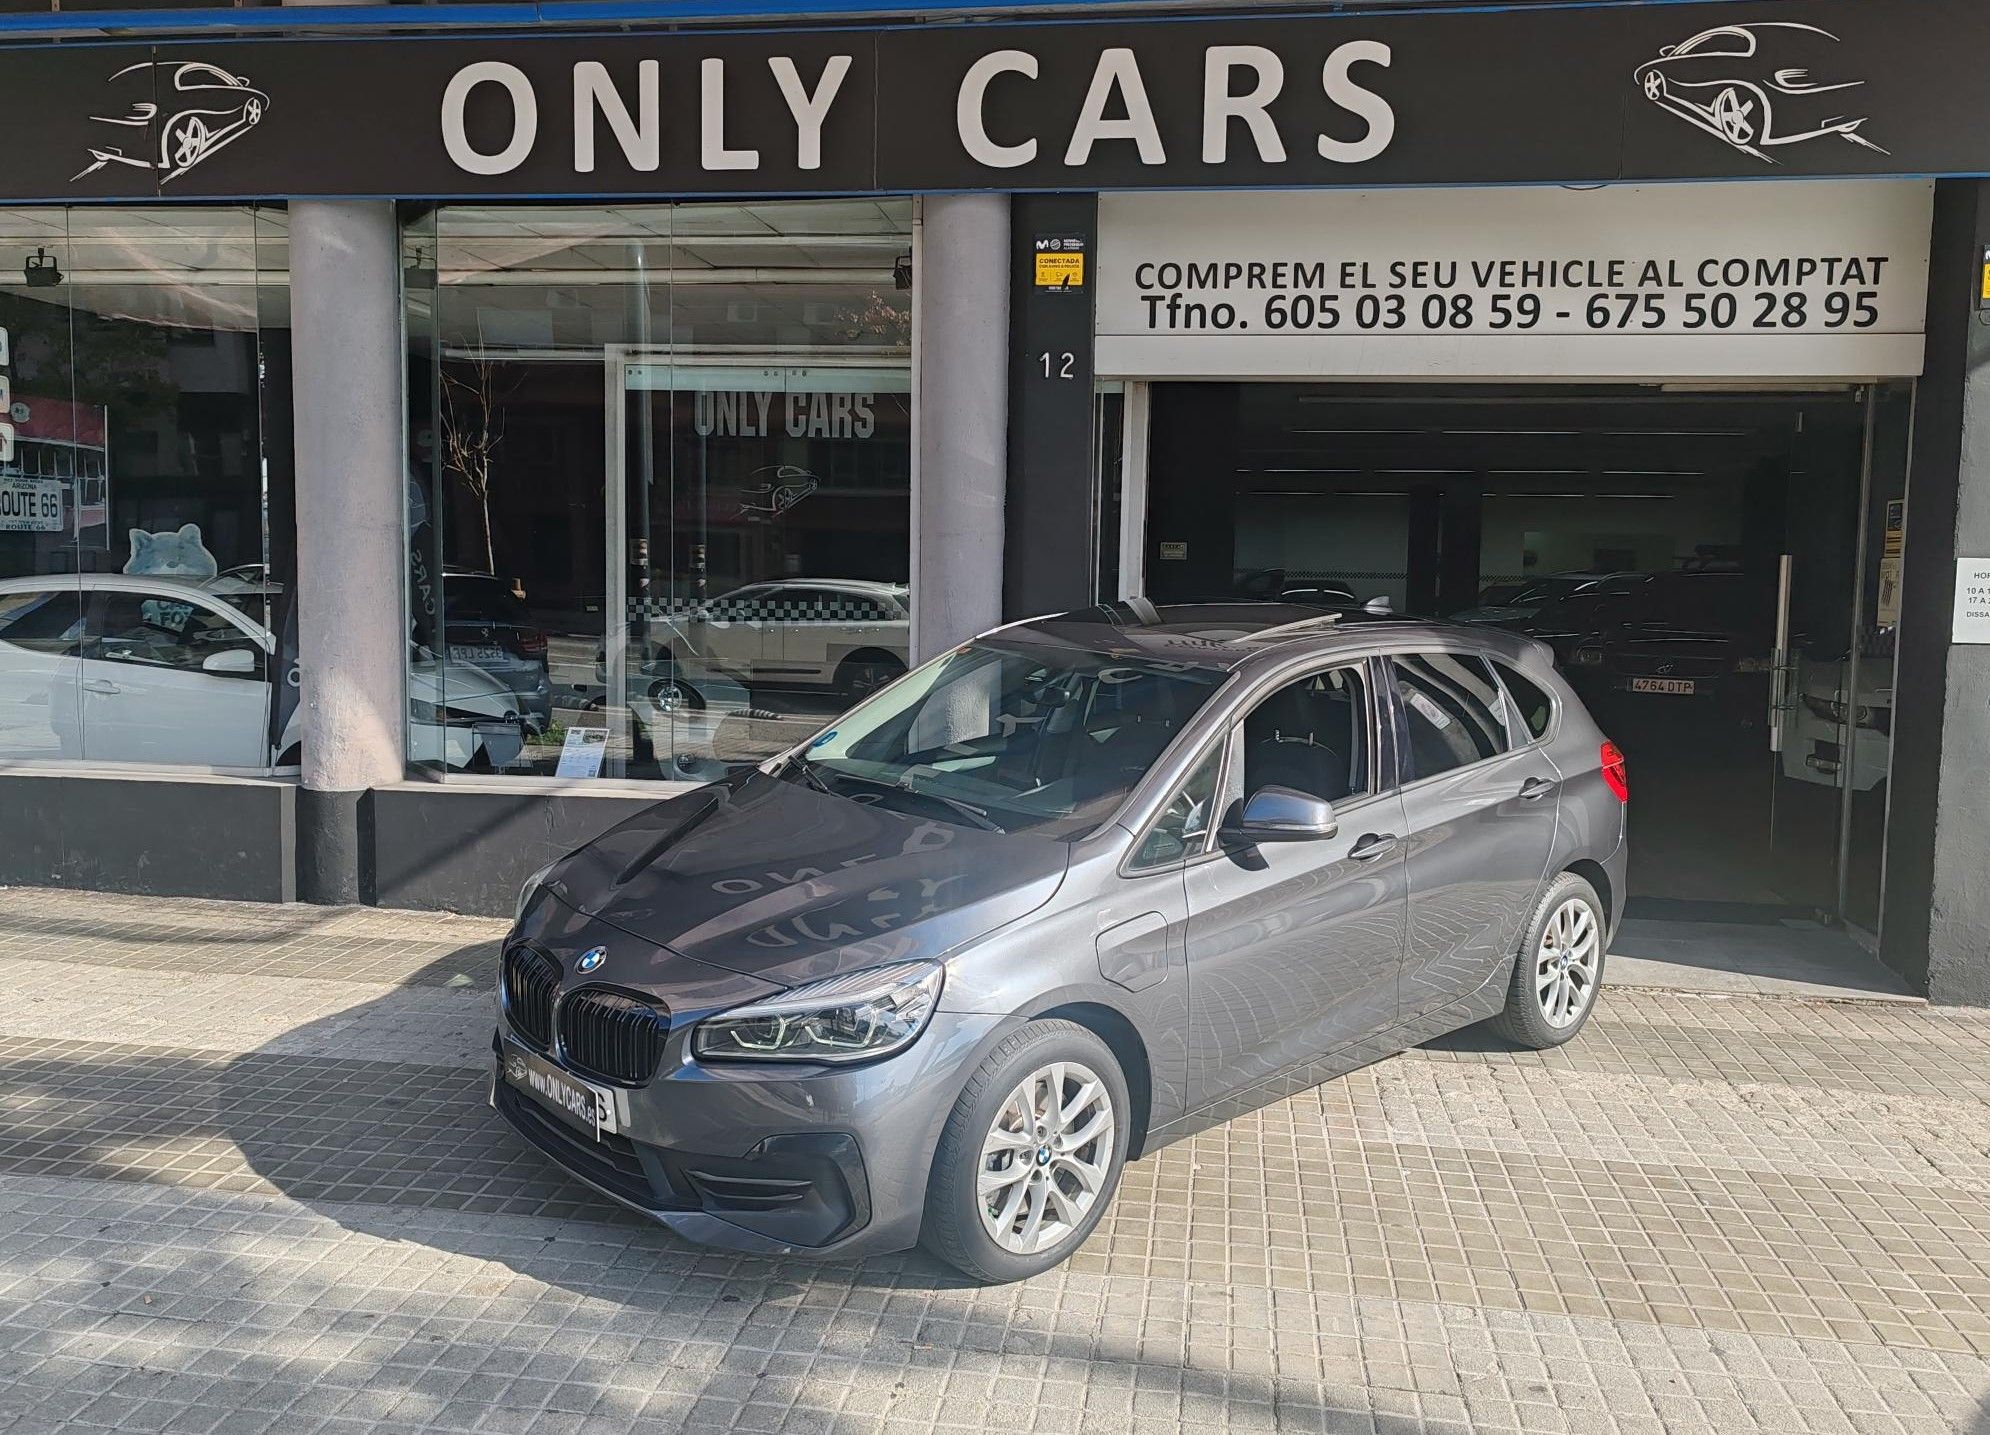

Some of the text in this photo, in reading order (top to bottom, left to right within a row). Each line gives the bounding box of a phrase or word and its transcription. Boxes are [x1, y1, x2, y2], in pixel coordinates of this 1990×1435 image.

[441, 40, 1396, 175] ONLY CARS
[1135, 257, 1888, 290] COMPREM EL SEU VEHICLE AL COMPTAT
[1141, 293, 1248, 329] Tfno.
[1264, 294, 1340, 329] 605
[1355, 294, 1406, 329] 03
[1421, 293, 1474, 329] 08
[1488, 293, 1541, 329] 59
[1586, 293, 1666, 329] 675
[1682, 293, 1737, 328] 50
[1752, 292, 1808, 328] 28
[1823, 292, 1879, 328] 95
[1040, 352, 1074, 379] 12
[694, 391, 875, 439] ONLY CARS
[0, 490, 58, 518] OUTE 66
[1967, 587, 1977, 595] 10
[1978, 587, 1985, 595] A
[1635, 680, 1692, 693] 4764 DTP
[528, 1068, 596, 1127] www.ONLYCARS.es
